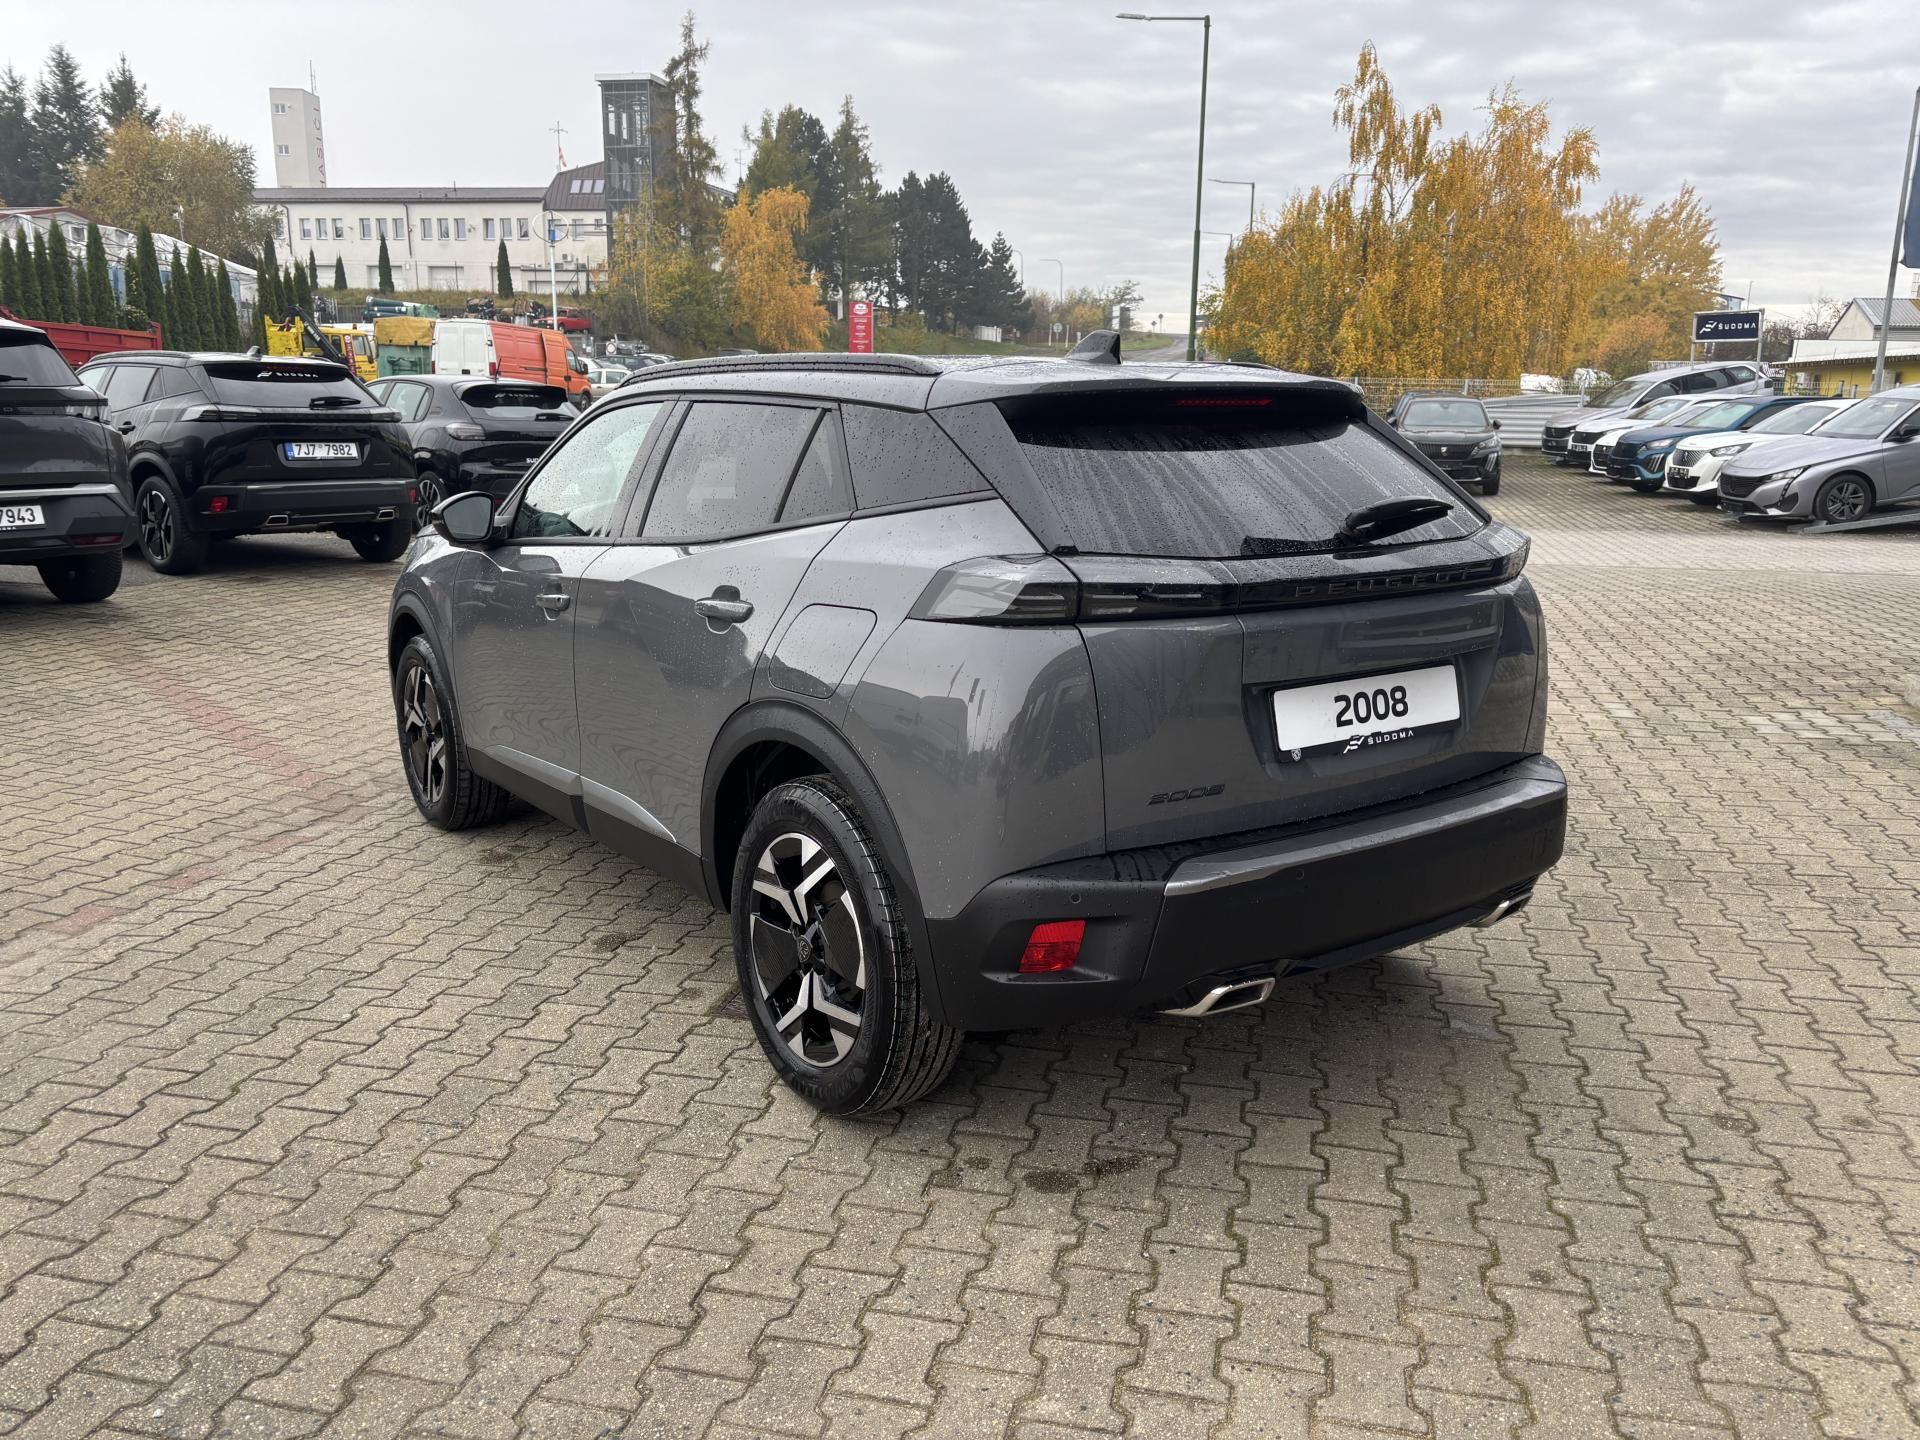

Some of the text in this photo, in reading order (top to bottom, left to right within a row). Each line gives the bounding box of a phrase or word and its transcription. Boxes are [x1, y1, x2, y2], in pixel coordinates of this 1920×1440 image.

[295, 444, 352, 456] 7J7 7982
[1295, 569, 1468, 598] PEUGEOT
[1334, 685, 1409, 728] 2008
